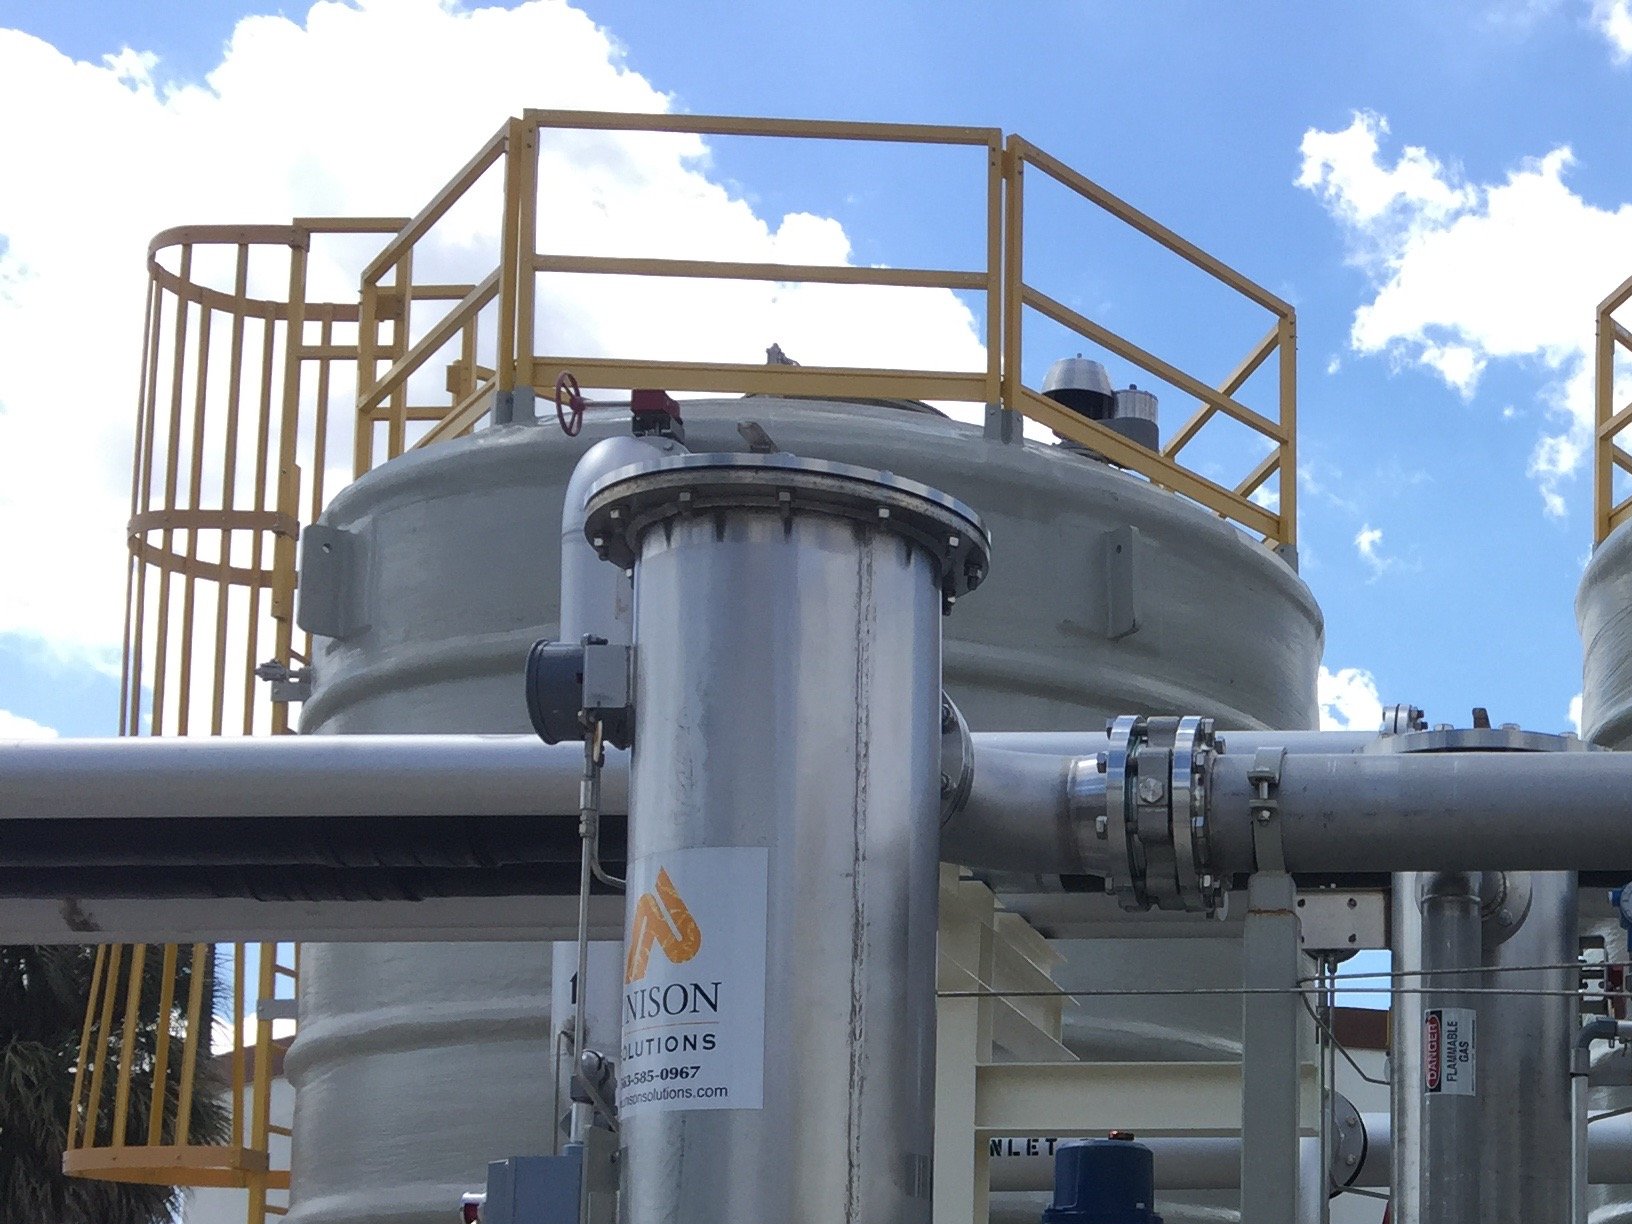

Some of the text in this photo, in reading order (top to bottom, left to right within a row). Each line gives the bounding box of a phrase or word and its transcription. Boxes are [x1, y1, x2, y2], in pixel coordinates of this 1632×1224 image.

[626, 982, 722, 1024] NISON
[622, 1033, 716, 1061] OLUTIONS
[1428, 1022, 1438, 1079] DANGER
[1447, 1021, 1458, 1082] FLAMMABLE
[1459, 1041, 1469, 1063] GAS
[990, 1138, 1058, 1157] NLET
